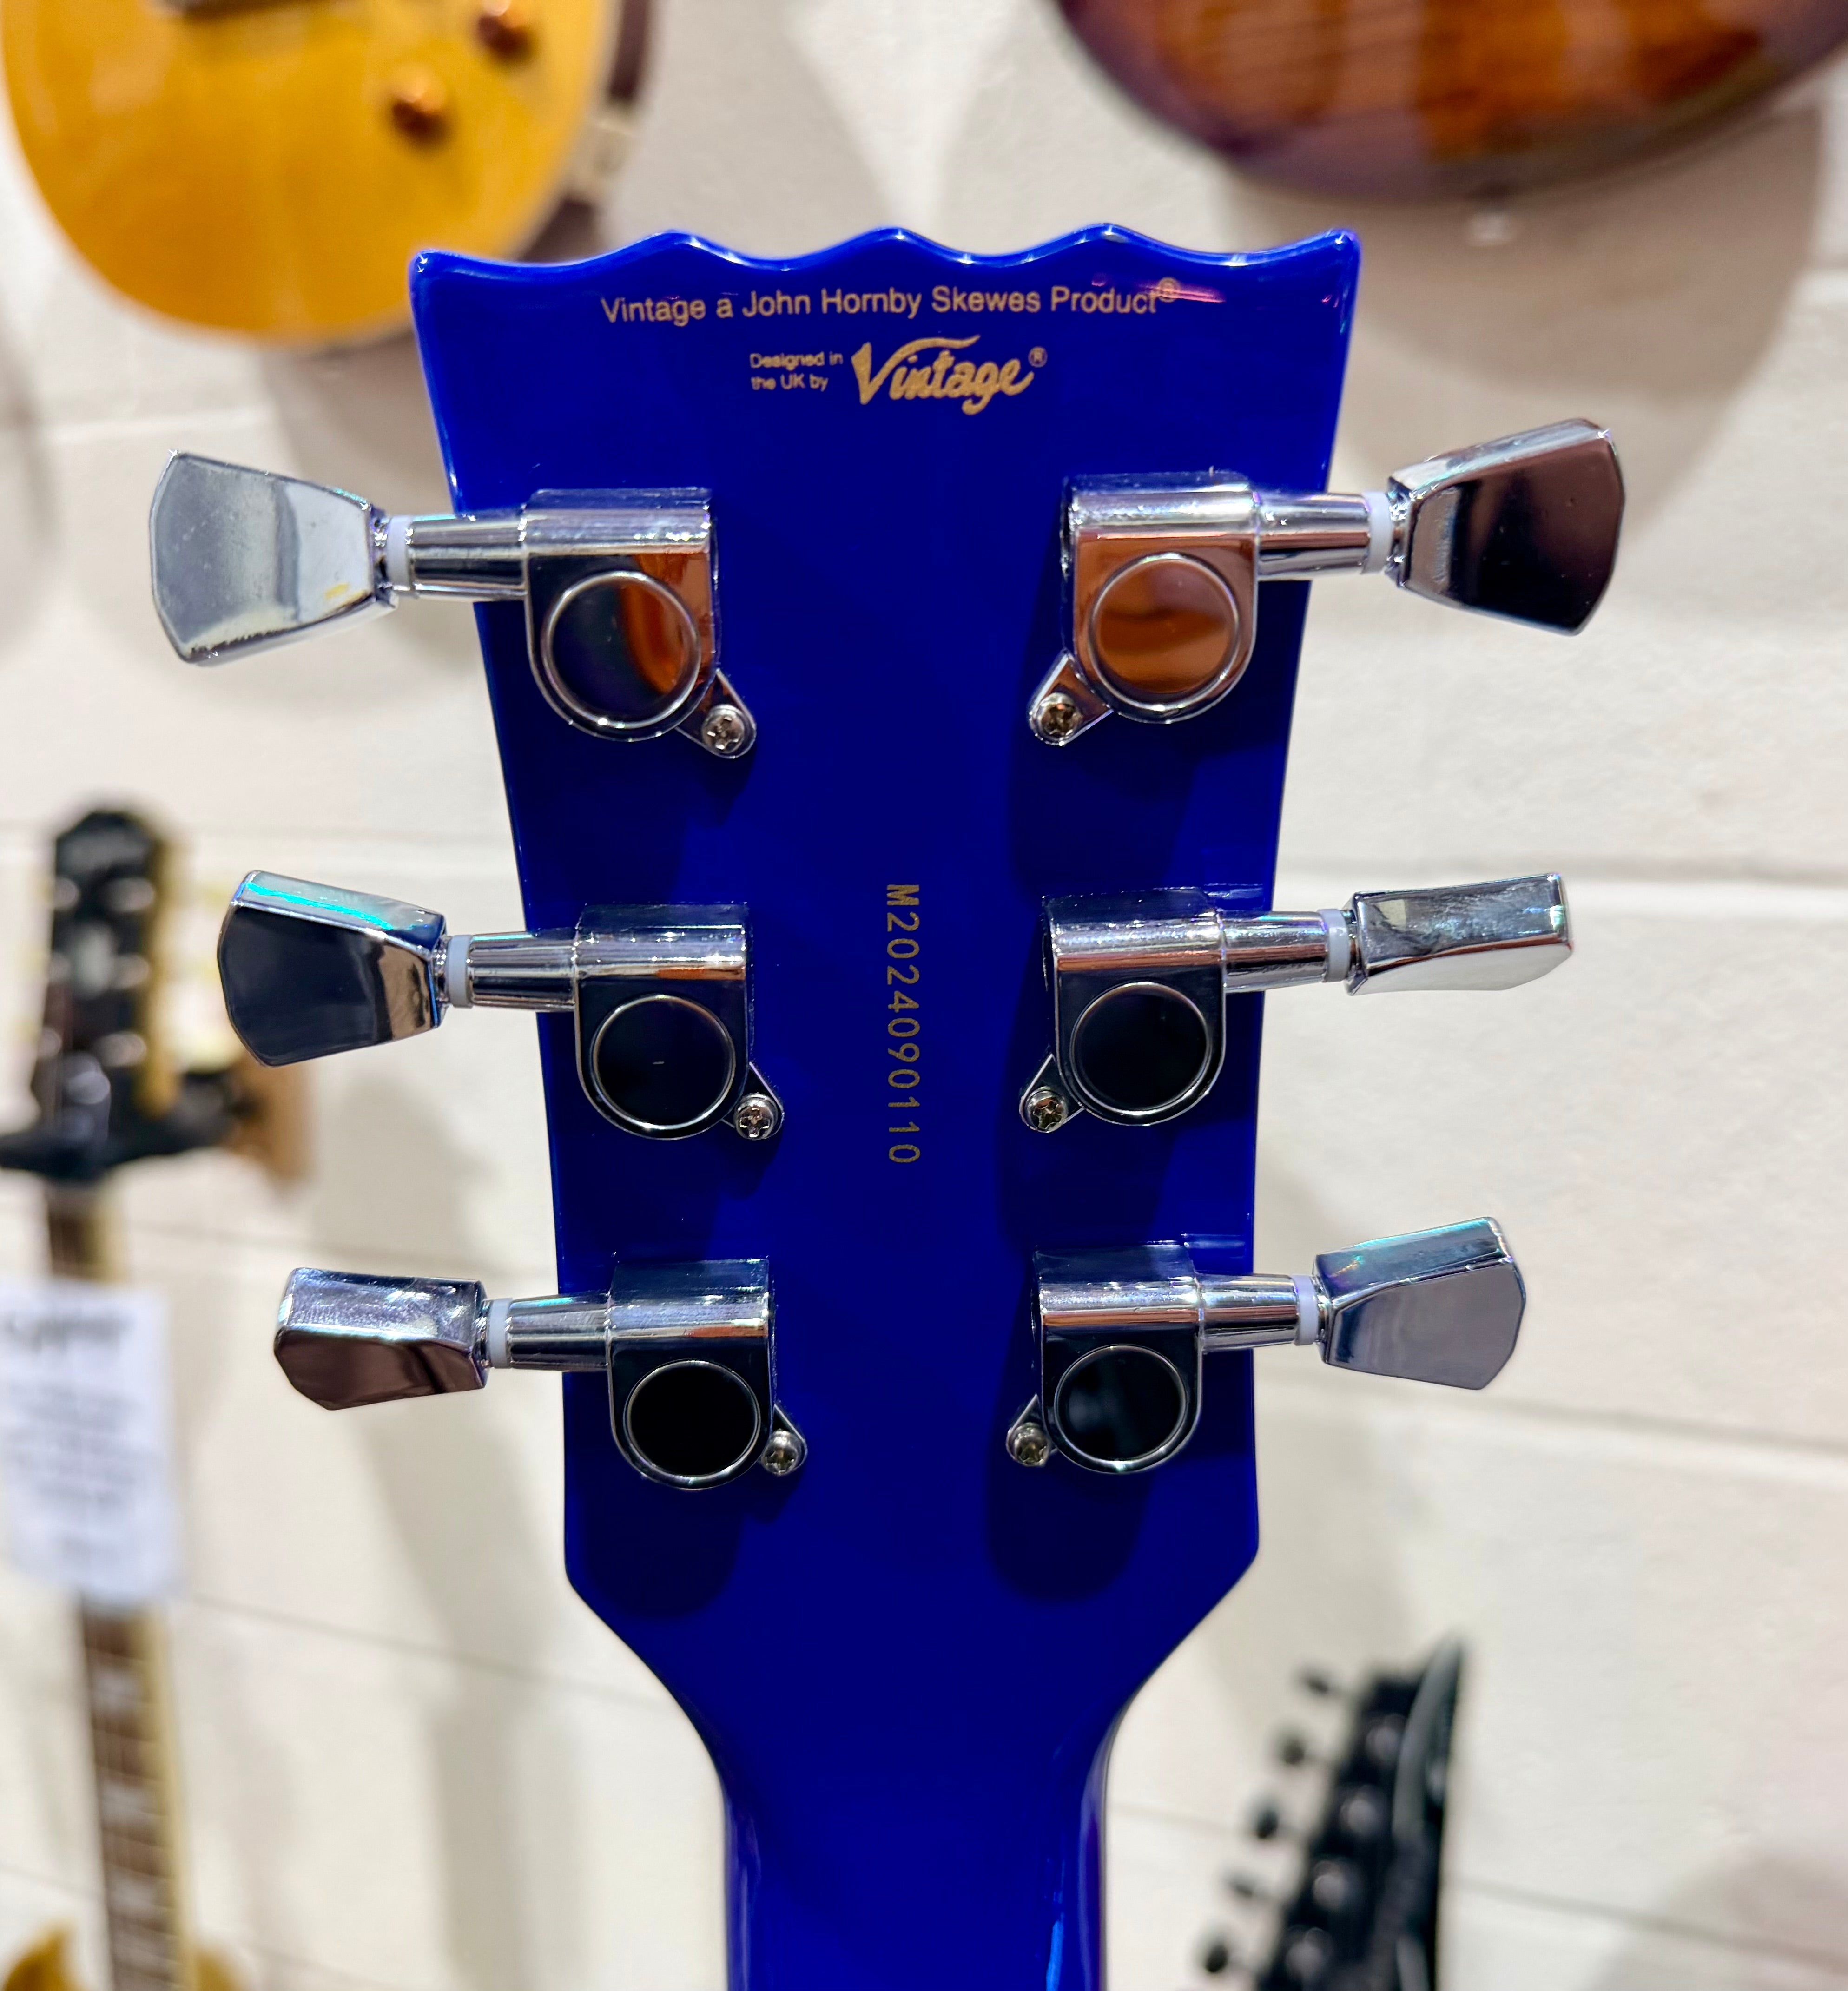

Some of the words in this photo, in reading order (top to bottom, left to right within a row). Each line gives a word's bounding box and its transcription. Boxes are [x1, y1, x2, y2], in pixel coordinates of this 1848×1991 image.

[601, 297, 706, 327] Vintage
[716, 297, 734, 318] a
[742, 289, 811, 317] John
[821, 287, 923, 319] Hornby
[931, 285, 1041, 313] Skewes
[750, 351, 825, 371] Designed
[829, 351, 844, 366] in
[750, 375, 777, 390] the
[779, 373, 806, 390] UK
[809, 373, 829, 392] by
[886, 884, 921, 1163] M2024090110
